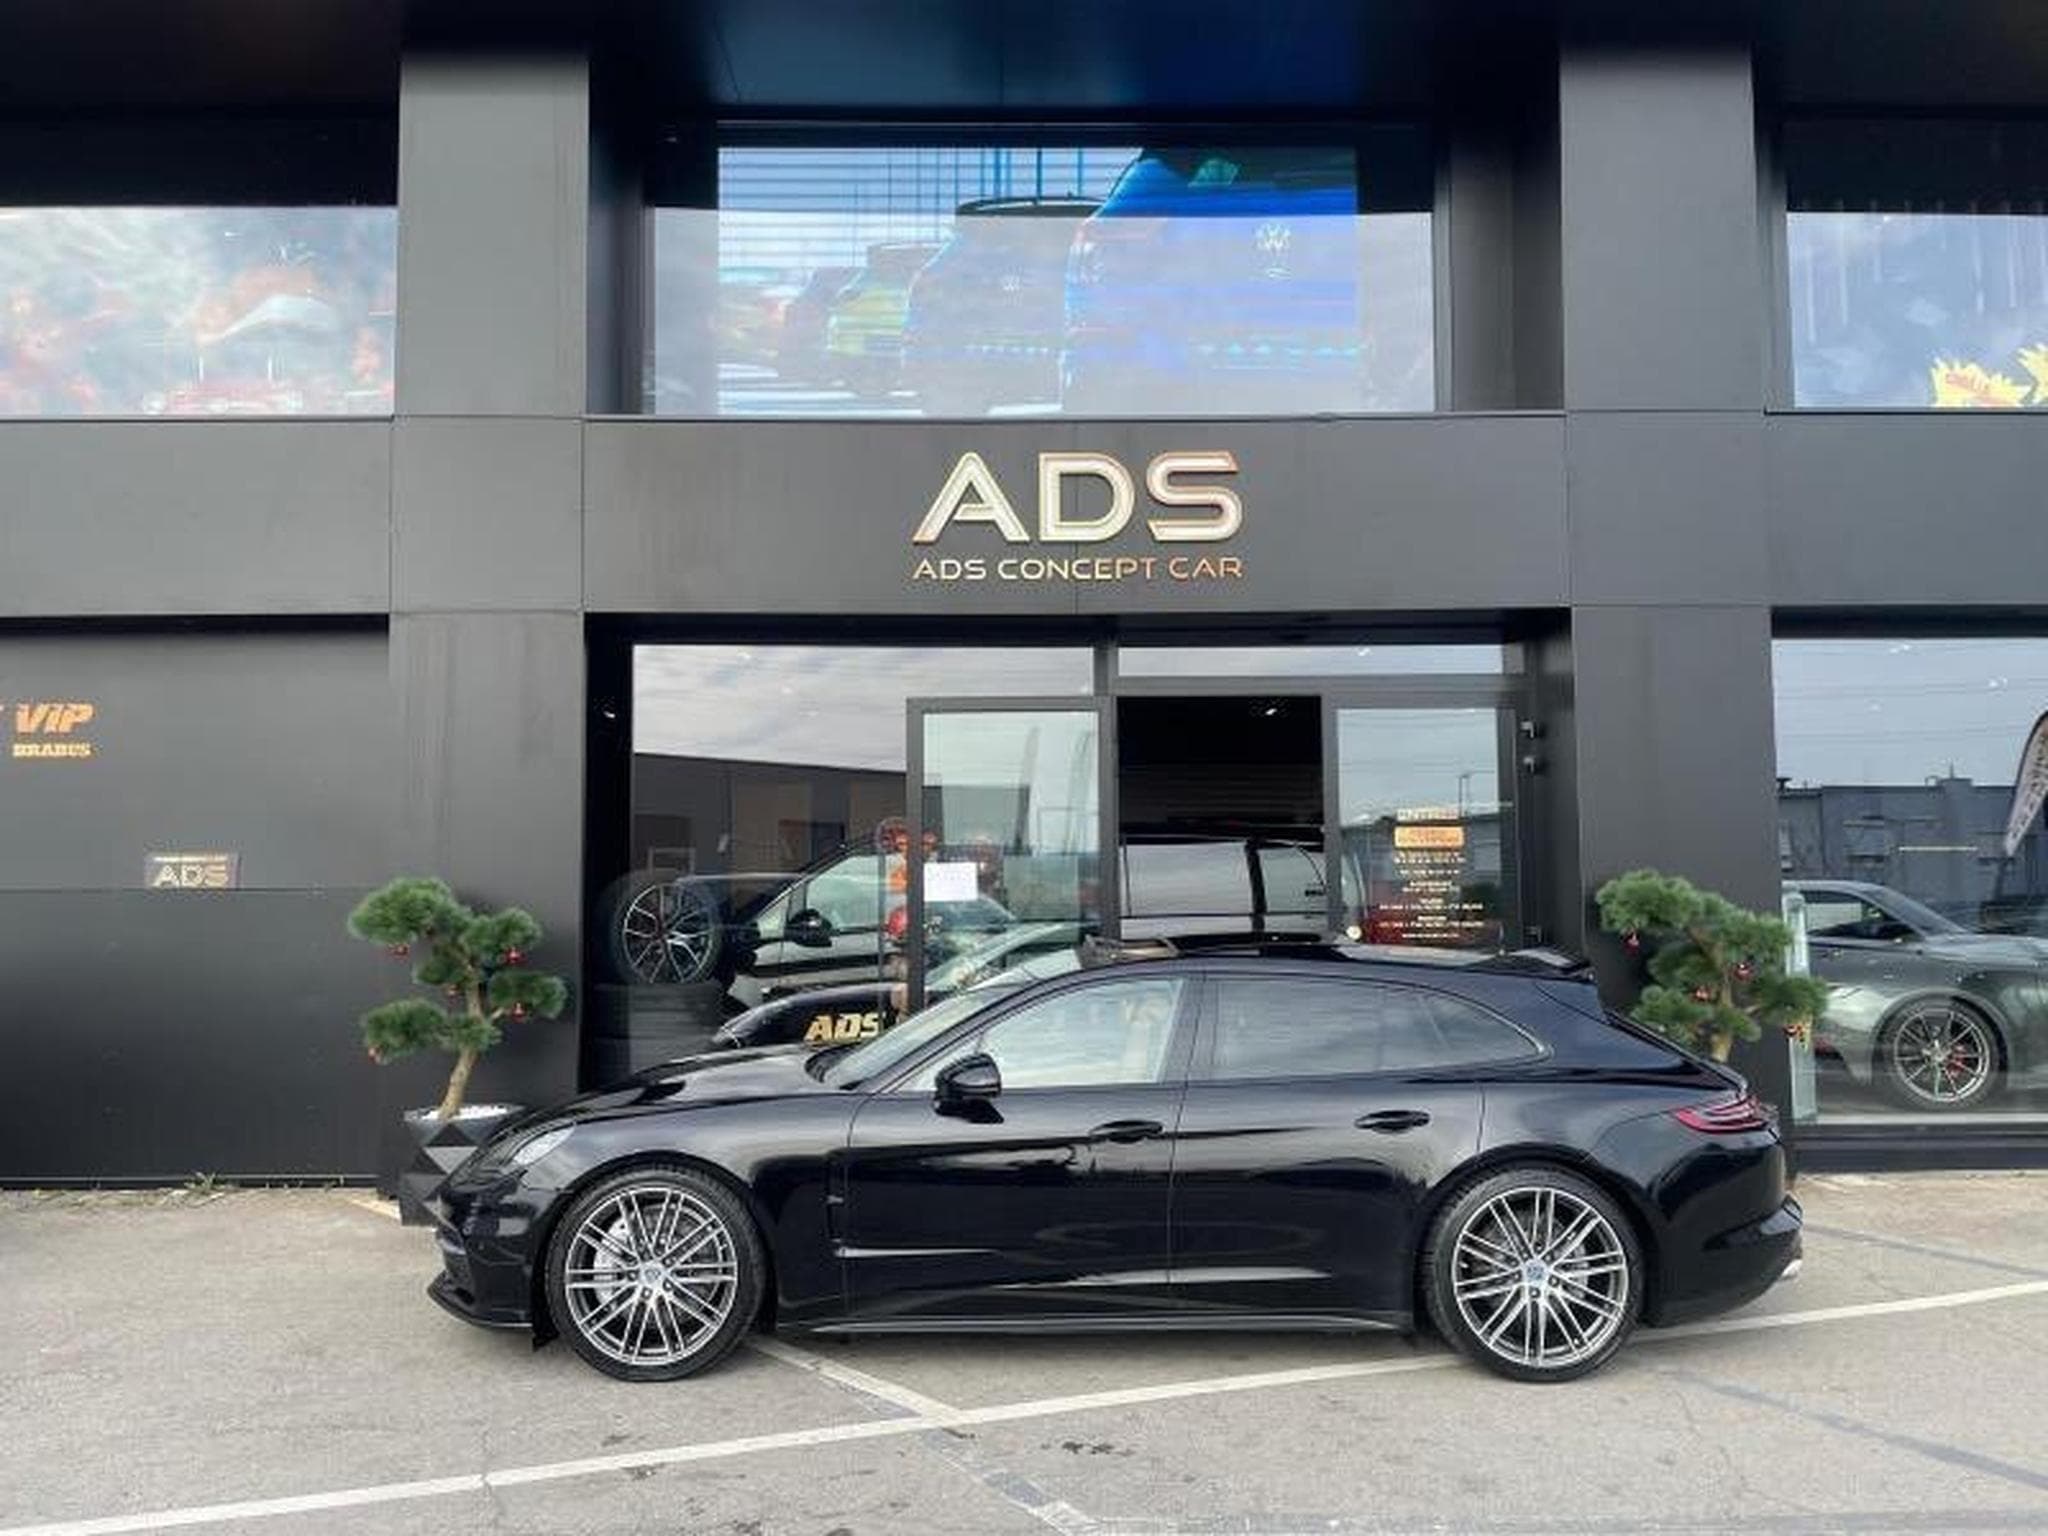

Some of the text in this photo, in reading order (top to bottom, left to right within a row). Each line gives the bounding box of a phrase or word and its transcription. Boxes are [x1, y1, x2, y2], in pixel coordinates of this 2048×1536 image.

[912, 451, 1243, 543] ADS
[912, 556, 1243, 580] ADS CONCEPT CAR
[153, 865, 229, 887] ADS
[804, 1012, 880, 1042] ADS
